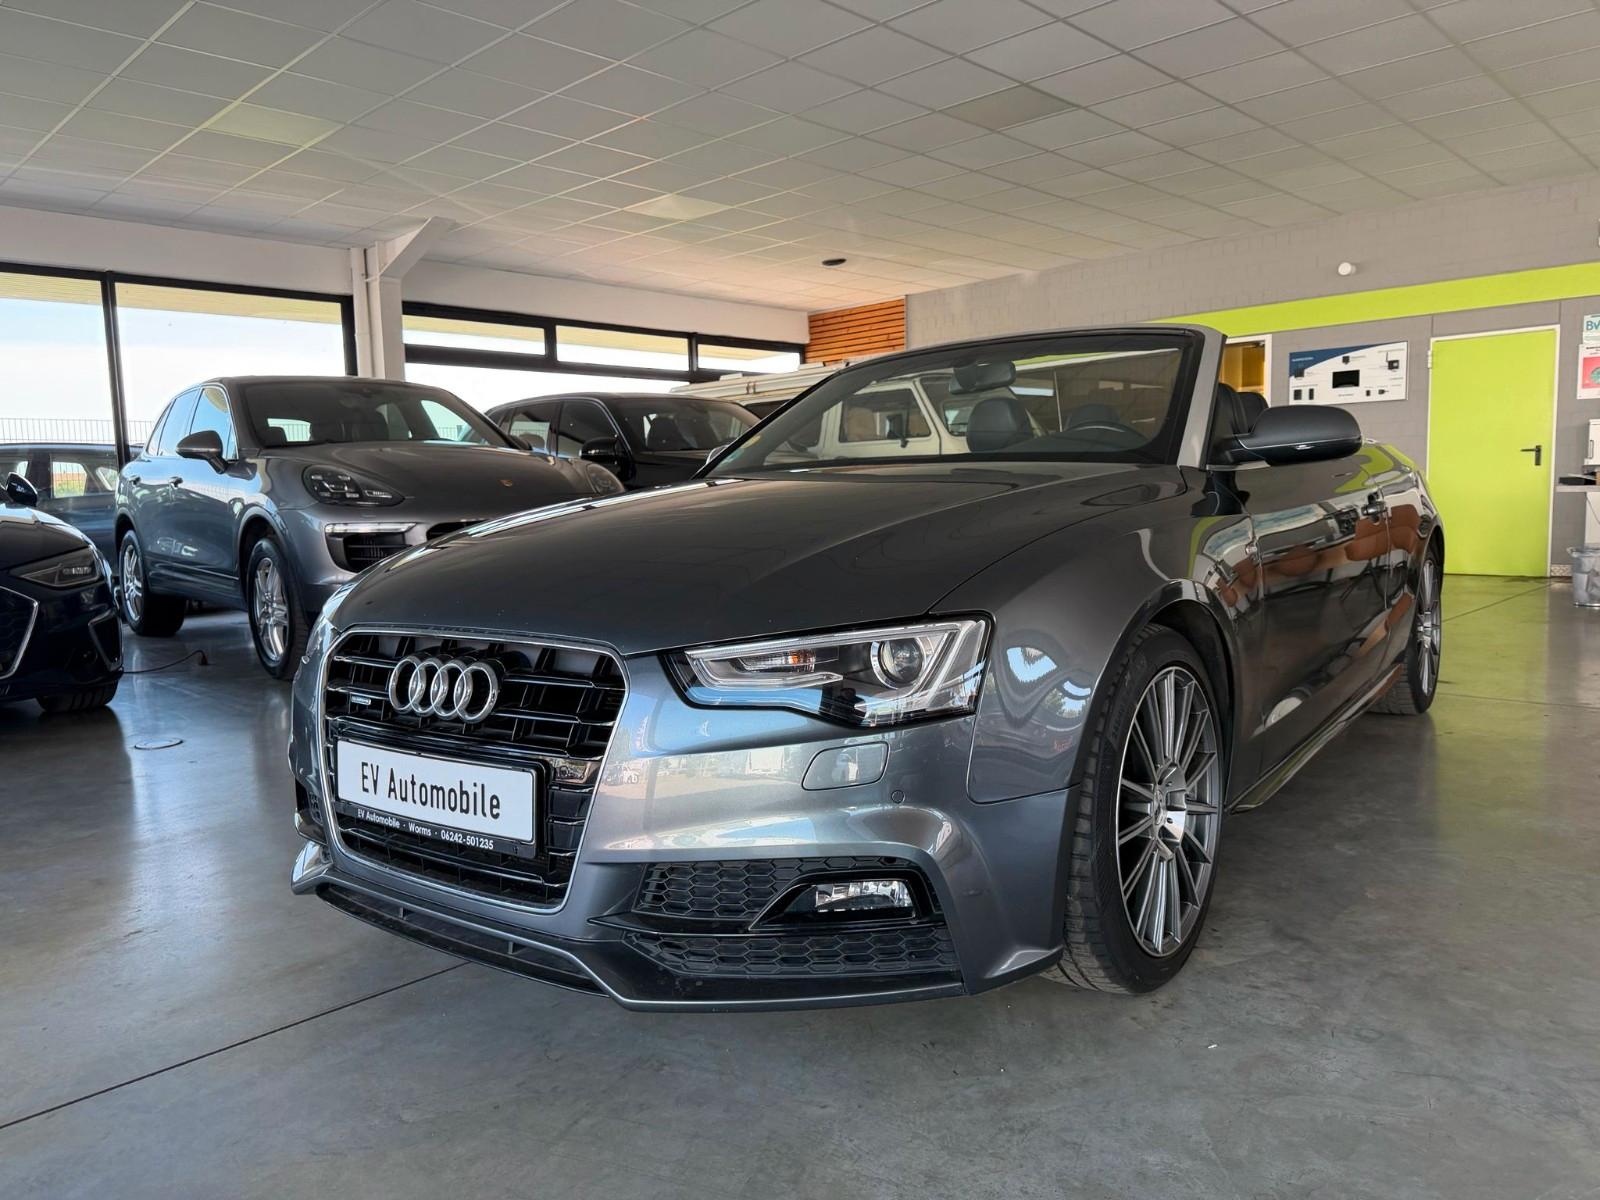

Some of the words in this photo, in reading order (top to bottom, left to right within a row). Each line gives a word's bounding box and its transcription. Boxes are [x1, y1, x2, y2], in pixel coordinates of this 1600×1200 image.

[361, 761, 379, 795] EV
[387, 767, 500, 820] Automobile
[357, 808, 365, 819] EV
[366, 811, 400, 829] Automobile
[408, 822, 432, 837] Worms
[440, 829, 494, 850] 06242-501235
